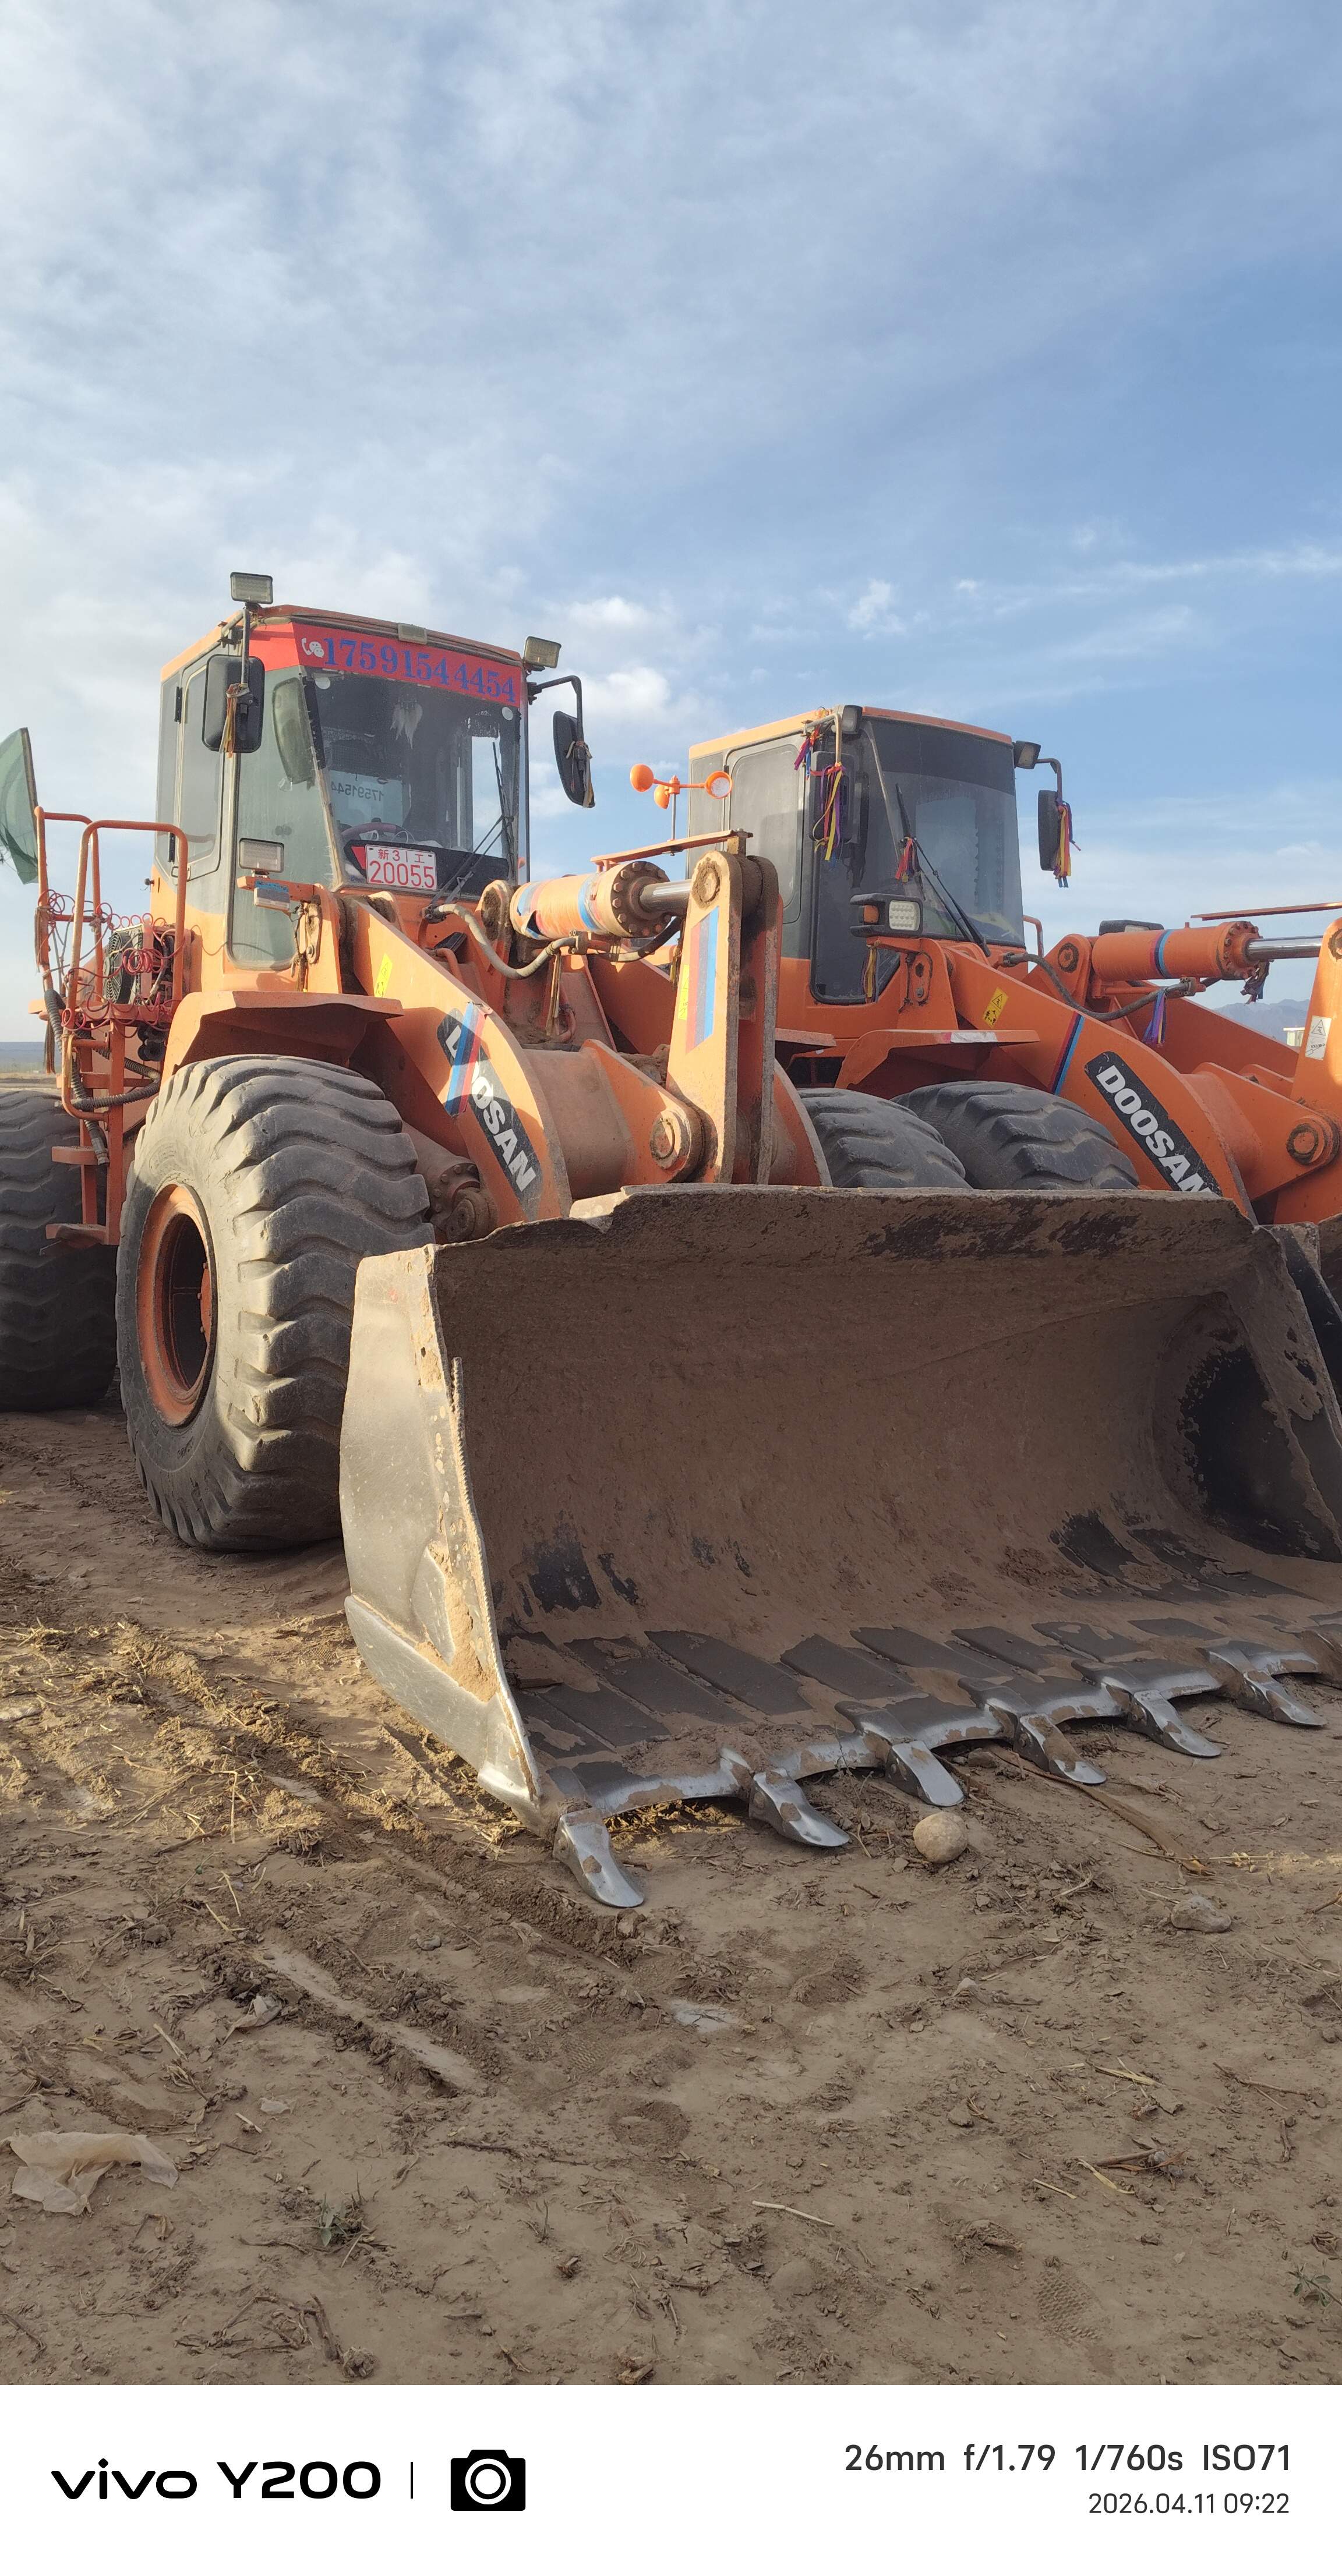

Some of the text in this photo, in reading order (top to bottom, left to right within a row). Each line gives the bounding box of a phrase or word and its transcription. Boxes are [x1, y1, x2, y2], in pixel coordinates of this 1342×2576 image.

[324, 637, 515, 703] 17591544454
[369, 860, 435, 888] 20055
[446, 1024, 536, 1192] OSAN
